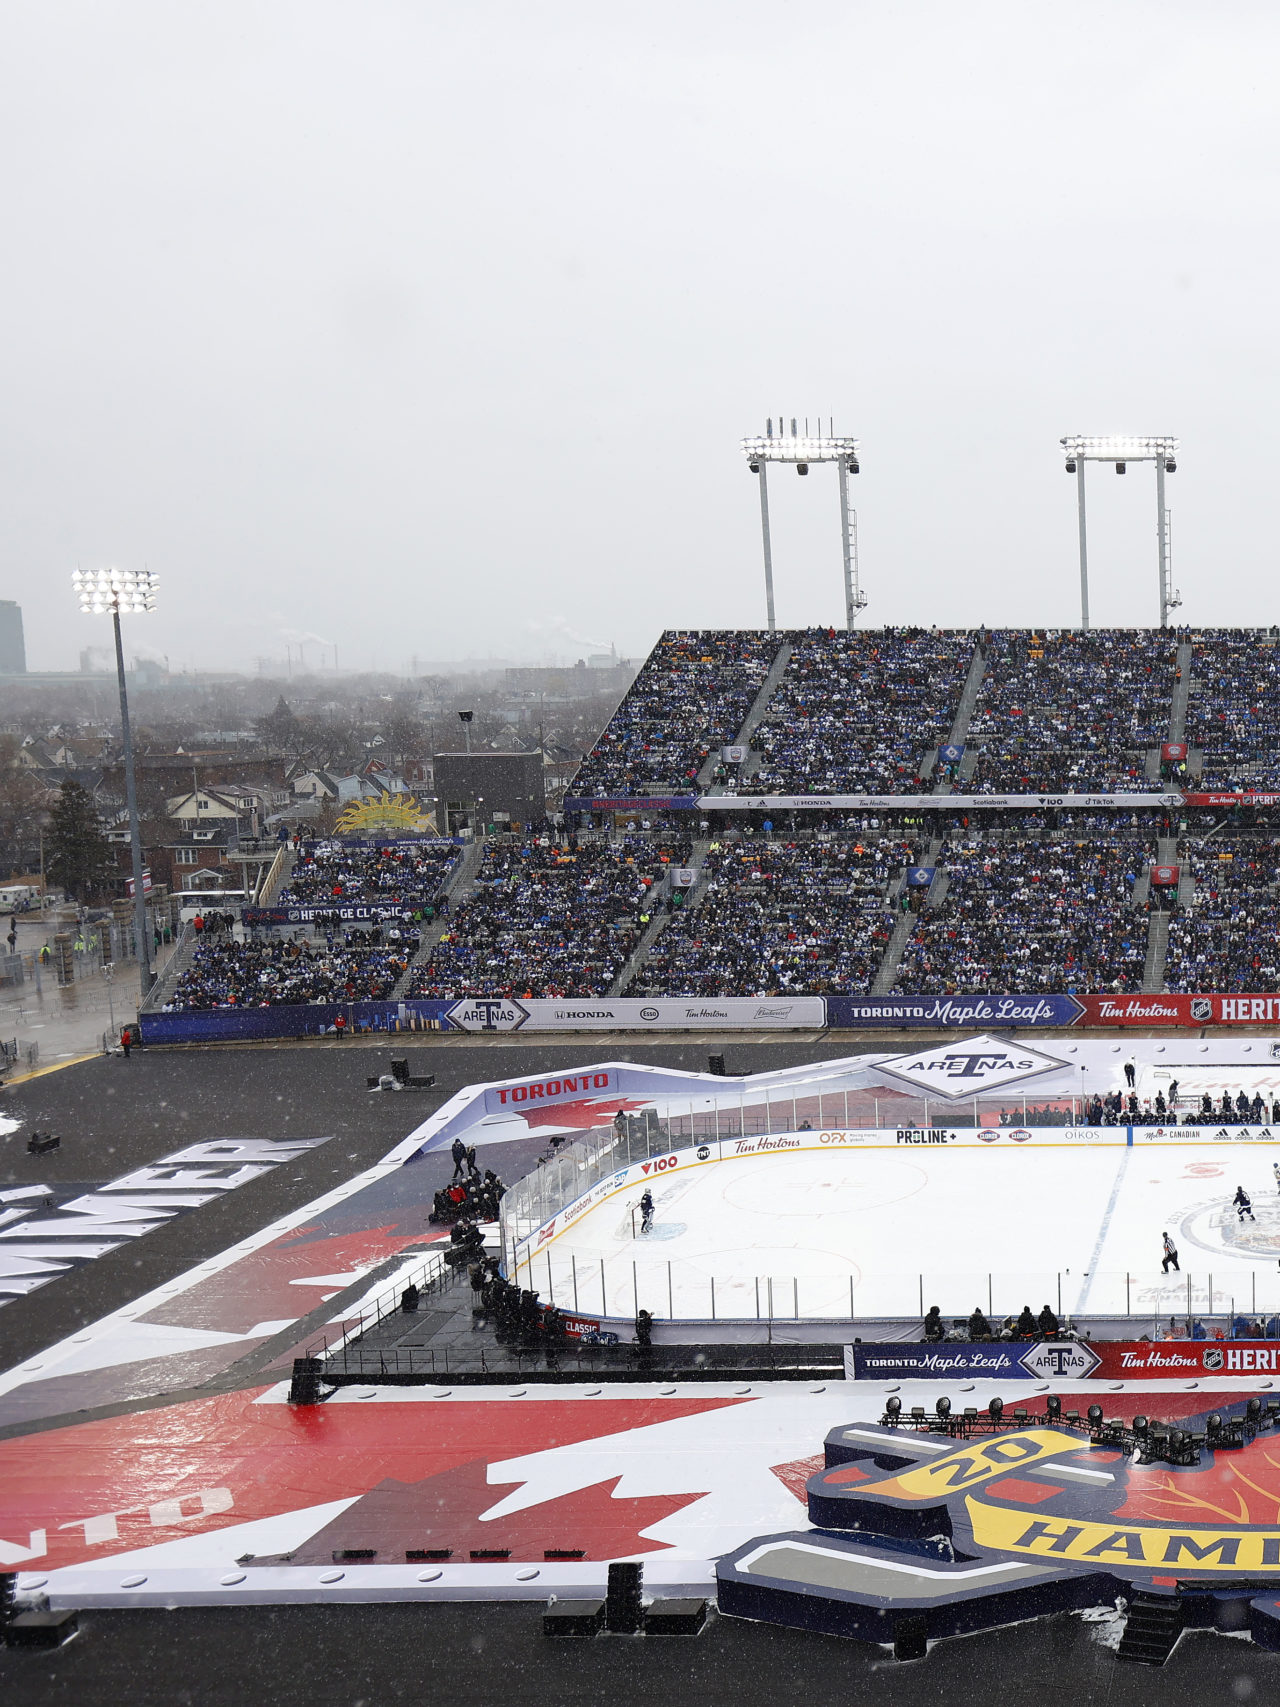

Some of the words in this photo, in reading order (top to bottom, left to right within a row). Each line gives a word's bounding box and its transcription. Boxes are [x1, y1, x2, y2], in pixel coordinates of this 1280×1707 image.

[566, 1011, 615, 1019] HONDA
[642, 1010, 658, 1018] Esso
[685, 1008, 700, 1019] Tim
[700, 1008, 729, 1018] Hortons
[851, 1007, 924, 1018] TORONTO
[924, 1000, 994, 1024] Maple
[995, 999, 1055, 1024] Leafs
[1098, 1001, 1124, 1018] Tim
[1125, 1001, 1179, 1018] Hortons
[496, 1073, 609, 1105] TORONTO
[819, 1132, 847, 1143] OFX
[897, 1130, 947, 1143] PROLINE
[1169, 1130, 1200, 1139] CANADIAN
[734, 1139, 756, 1154] Tim
[756, 1136, 800, 1152] Hortons
[653, 1155, 678, 1173] 100
[564, 1196, 593, 1223] Scotiabank
[865, 1359, 917, 1367] TORONTO
[918, 1354, 969, 1371] Maple
[969, 1353, 1011, 1371] Leafs
[1120, 1352, 1145, 1368] Tim
[1146, 1352, 1198, 1368] Hortons
